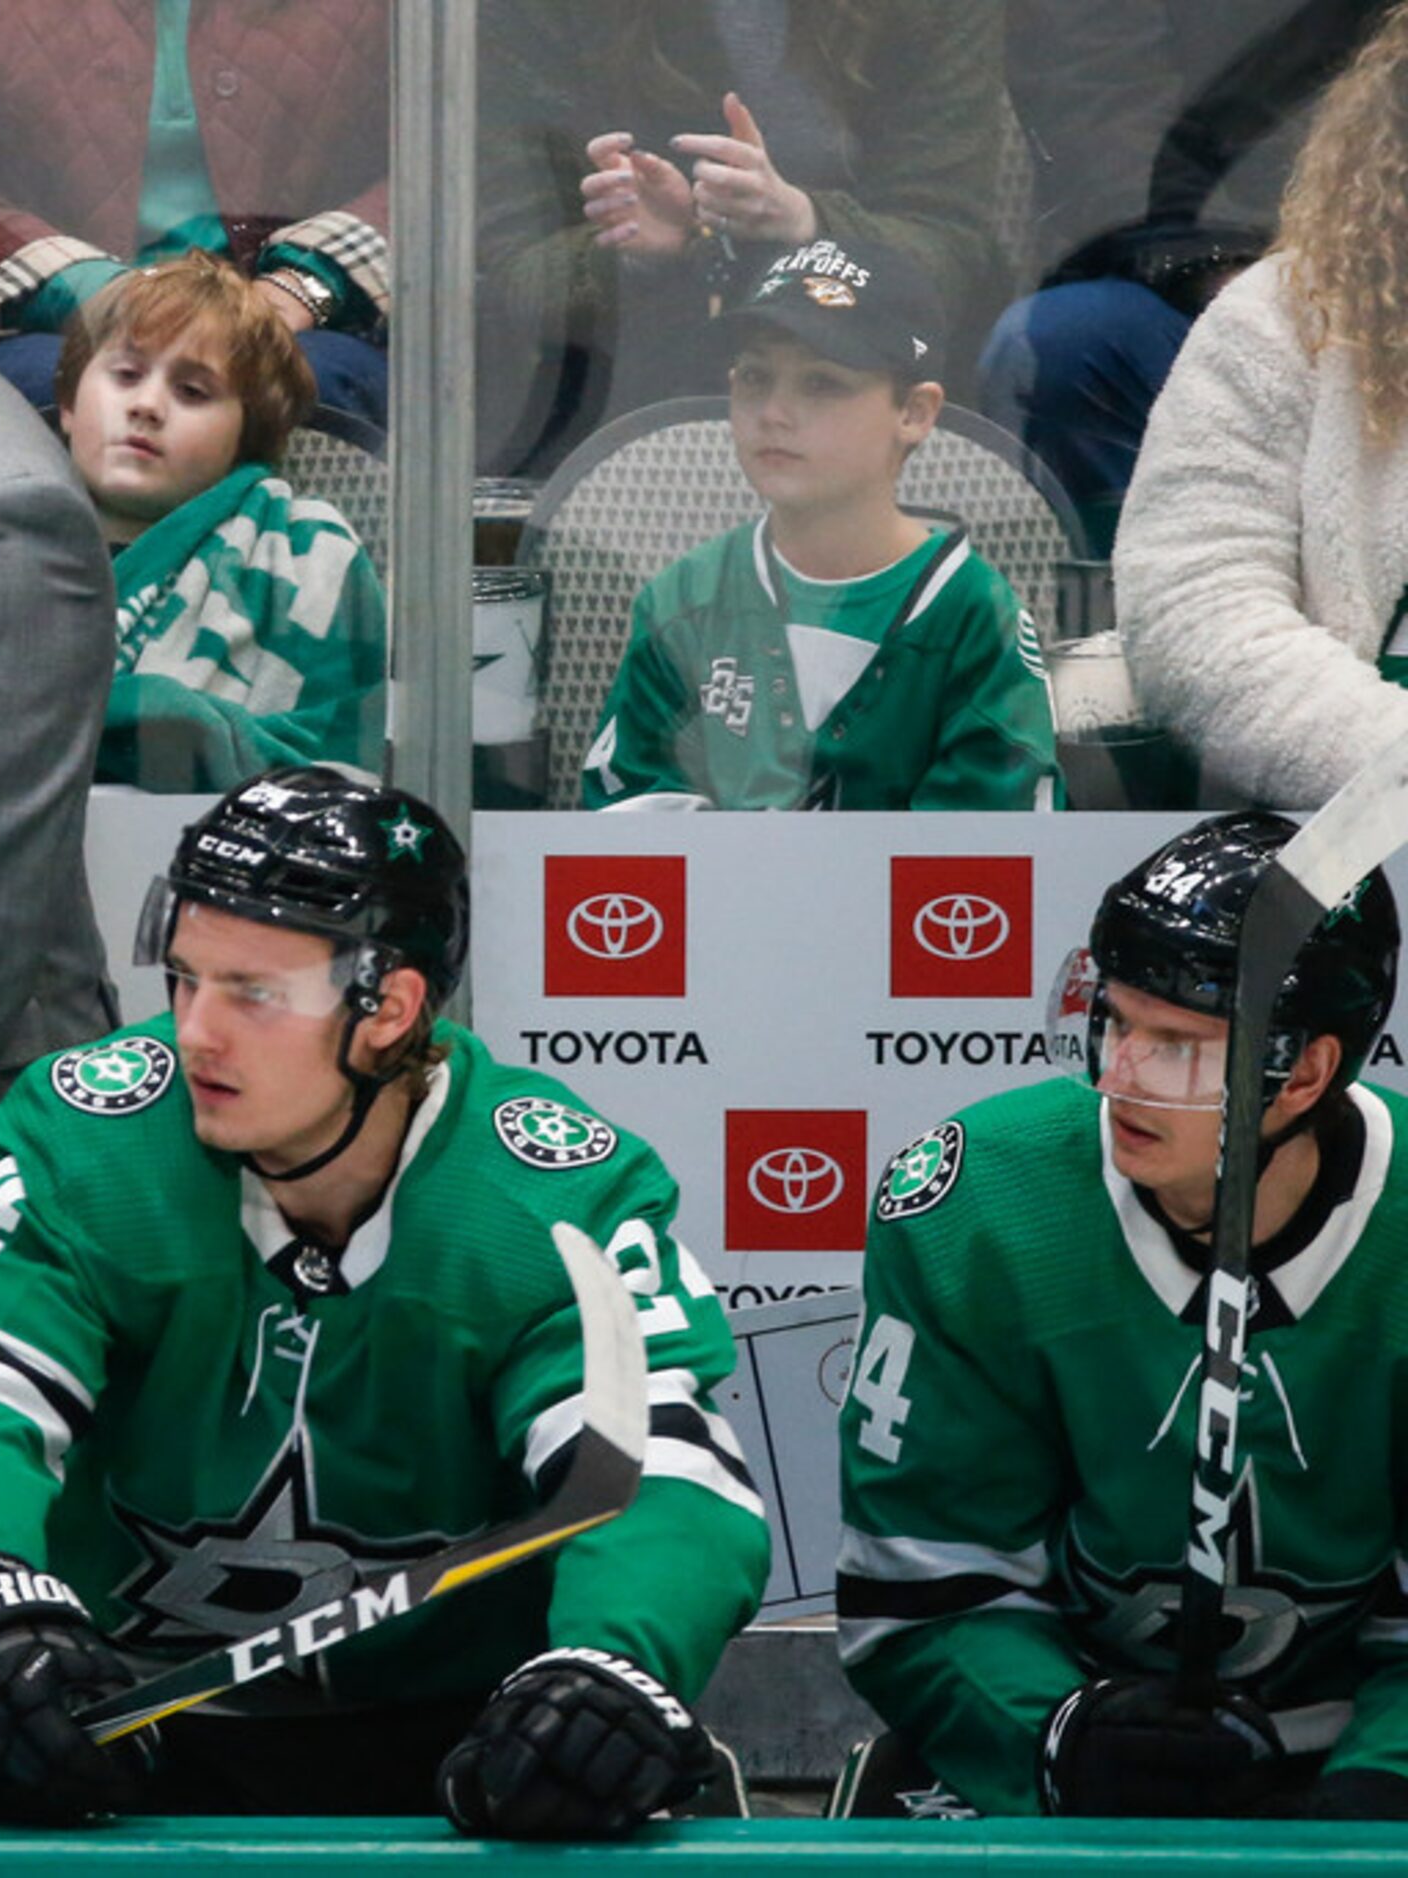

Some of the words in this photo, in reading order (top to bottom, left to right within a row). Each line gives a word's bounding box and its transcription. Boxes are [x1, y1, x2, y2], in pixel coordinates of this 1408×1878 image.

[197, 834, 267, 866] CCM
[520, 1030, 709, 1065] TOYOTA
[866, 1030, 1052, 1065] TOYOTA
[1188, 1268, 1247, 1586] CCM
[226, 1571, 412, 1684] CCM
